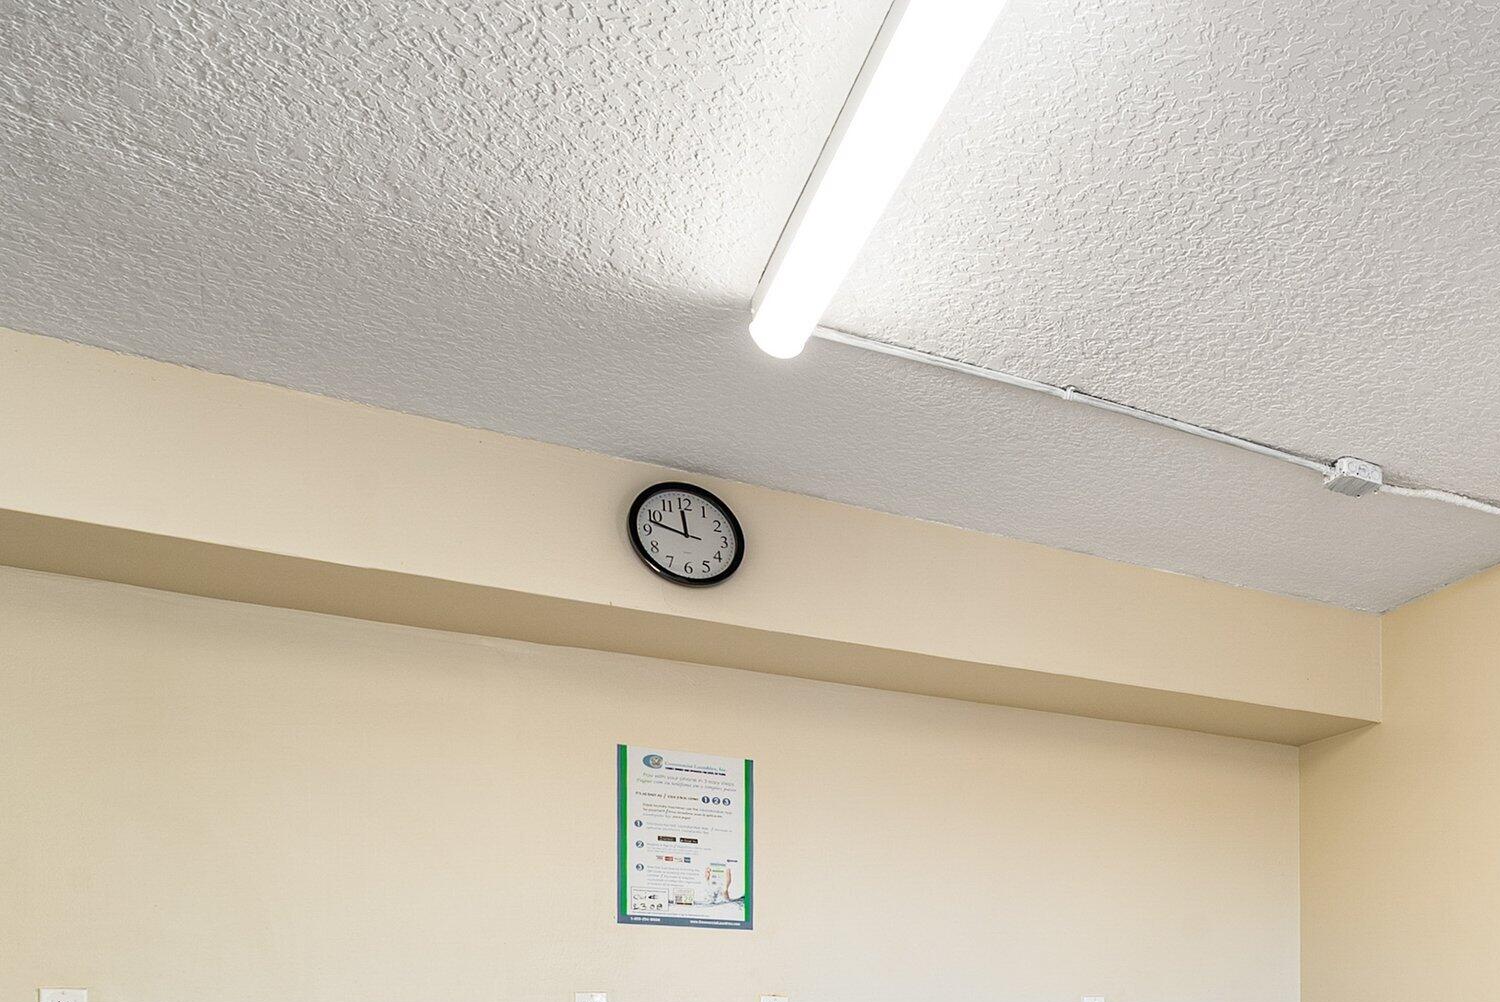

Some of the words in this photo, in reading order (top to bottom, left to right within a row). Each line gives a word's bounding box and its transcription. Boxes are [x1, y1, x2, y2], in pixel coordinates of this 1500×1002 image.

[662, 499, 673, 512] 11
[678, 497, 692, 511] 12
[648, 509, 662, 522] 10
[701, 506, 707, 518] 1
[643, 524, 652, 536] 9
[713, 520, 722, 532] 2
[650, 540, 659, 553] 8
[720, 536, 728, 549] 3
[665, 555, 674, 568] 7
[713, 551, 722, 563] 4
[684, 562, 693, 574] 6
[702, 561, 711, 573] 5
